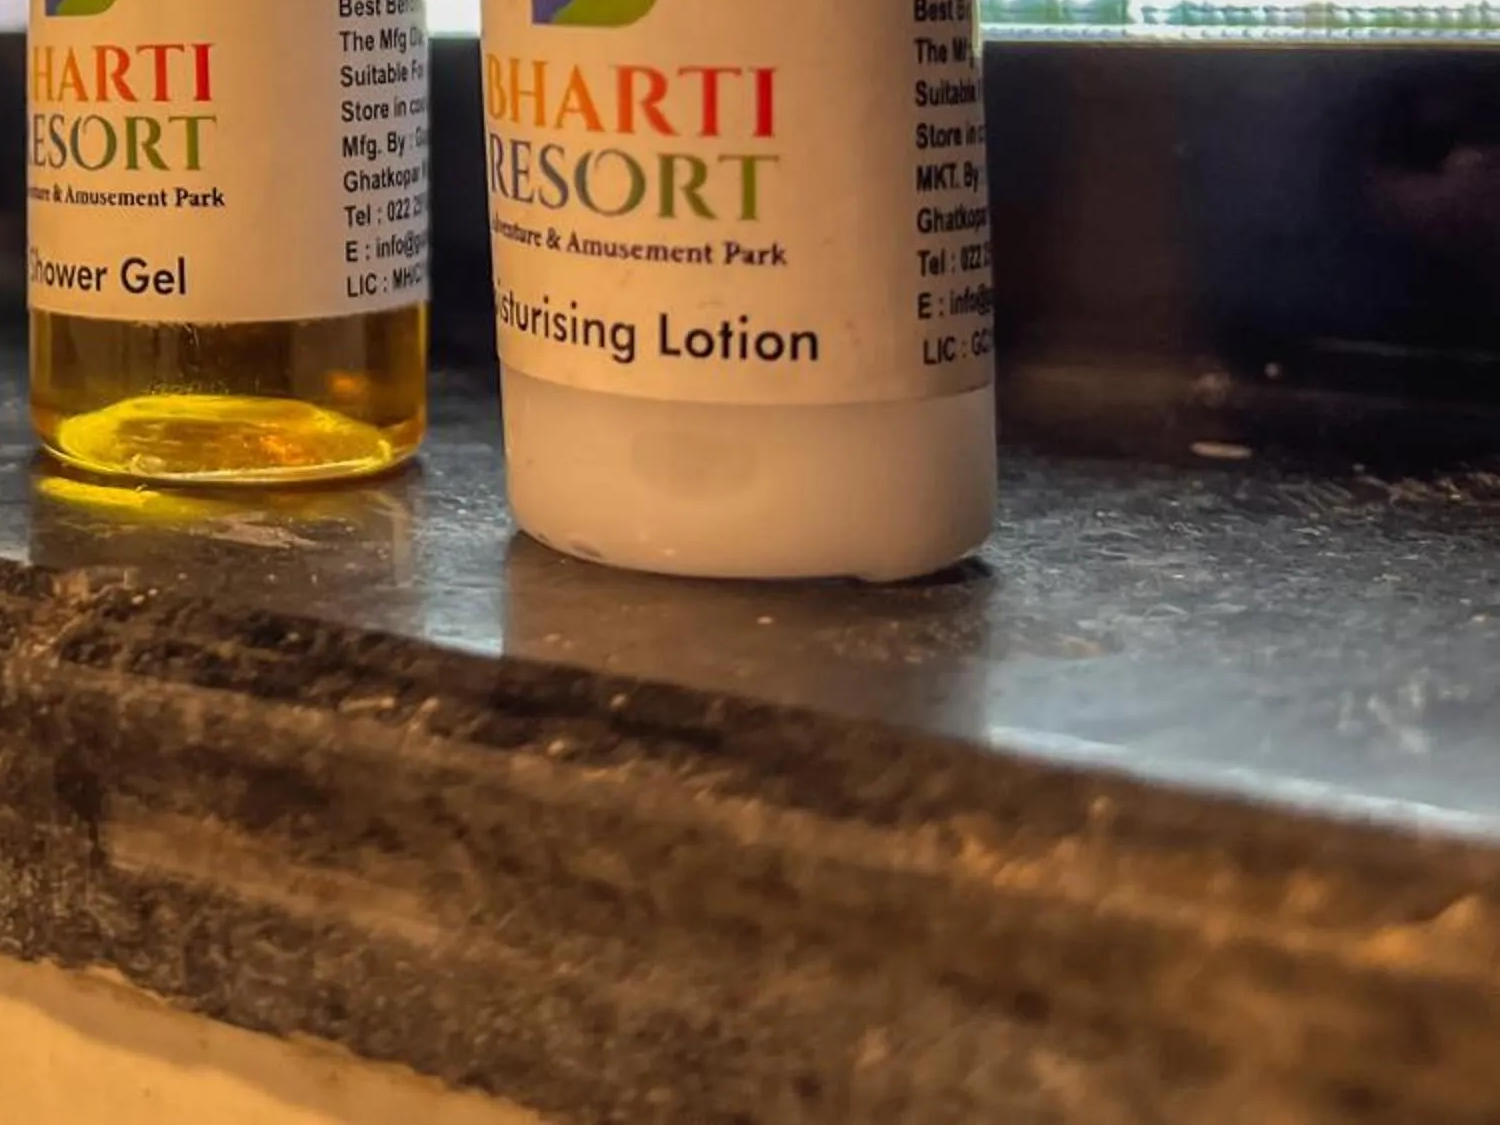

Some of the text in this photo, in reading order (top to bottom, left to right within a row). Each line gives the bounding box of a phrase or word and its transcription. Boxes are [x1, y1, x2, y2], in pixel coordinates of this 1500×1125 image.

[340, 29, 374, 53] The
[379, 25, 407, 54] Mfg
[914, 37, 948, 66] The
[340, 61, 408, 88] Suitable
[341, 99, 389, 124] Store
[393, 95, 407, 118] in
[486, 54, 779, 138] BHARTI
[30, 113, 217, 171] ESORT
[342, 135, 383, 162] Mfg.
[387, 130, 405, 157] By
[915, 122, 962, 150] Store
[488, 131, 781, 221] RESORT
[65, 185, 167, 207] Amusement
[175, 187, 226, 208] Park
[344, 202, 371, 228] Tel
[387, 197, 410, 222] 022
[917, 203, 987, 235] Ghatkopa
[346, 240, 359, 264] E
[546, 226, 561, 251] &
[566, 231, 713, 265] Amusement
[721, 240, 789, 266] Park
[120, 256, 186, 295] Gel
[917, 248, 946, 277] Tel
[347, 272, 377, 299] LIC
[918, 291, 933, 320] E
[495, 278, 820, 365] isturising Lotion
[922, 335, 956, 366] LIC
